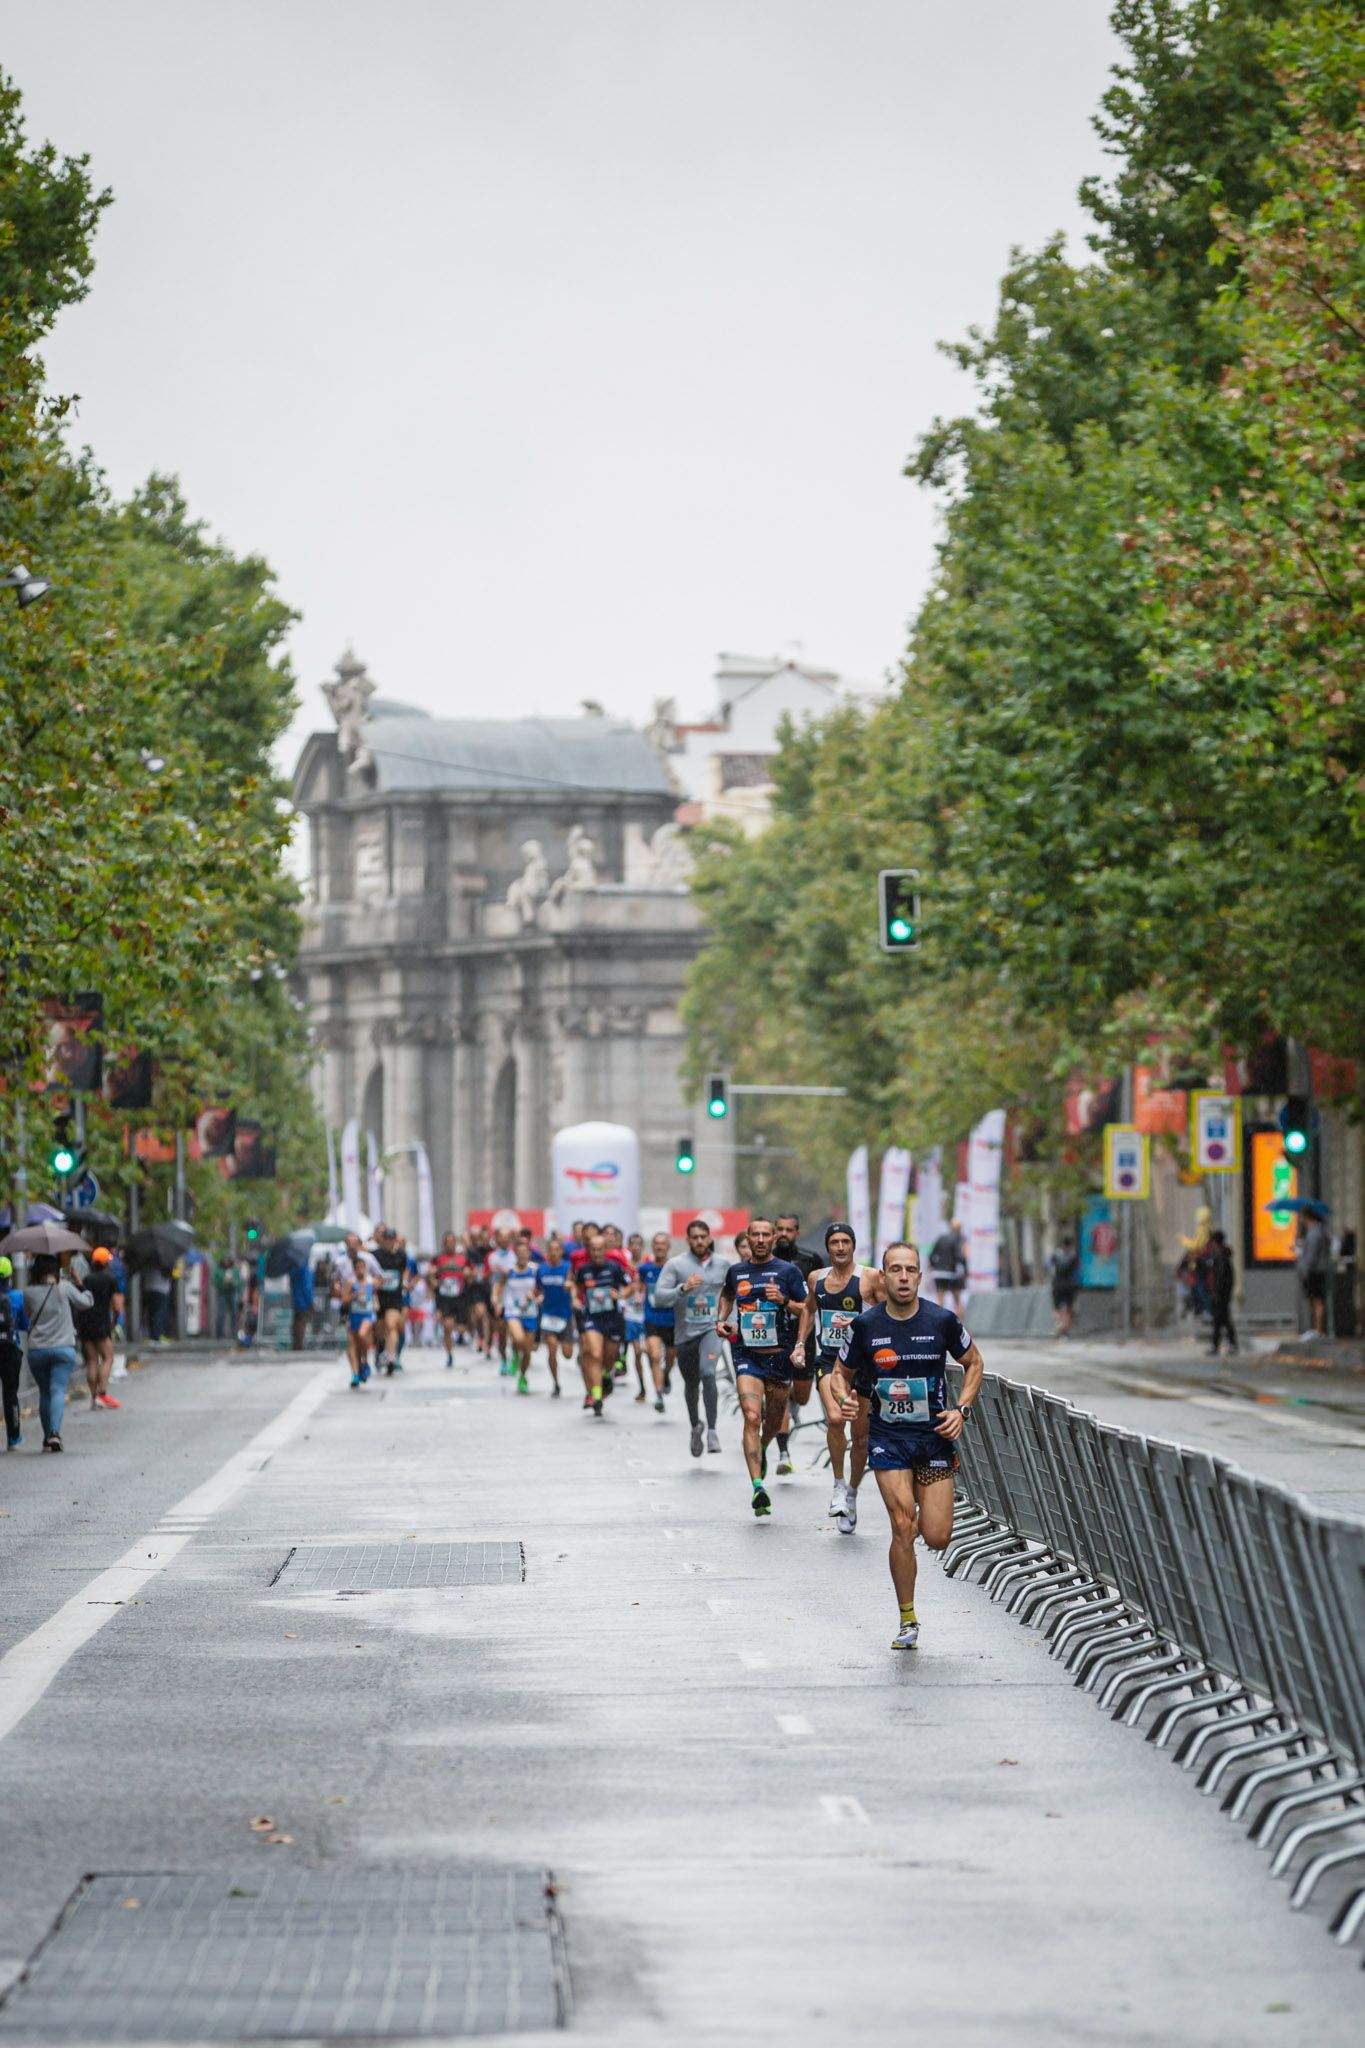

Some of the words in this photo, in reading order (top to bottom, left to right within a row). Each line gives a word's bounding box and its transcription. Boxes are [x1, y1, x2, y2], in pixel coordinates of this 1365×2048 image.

[751, 1329, 767, 1339] 133
[829, 1328, 847, 1340] 285
[889, 1401, 914, 1414] 283
